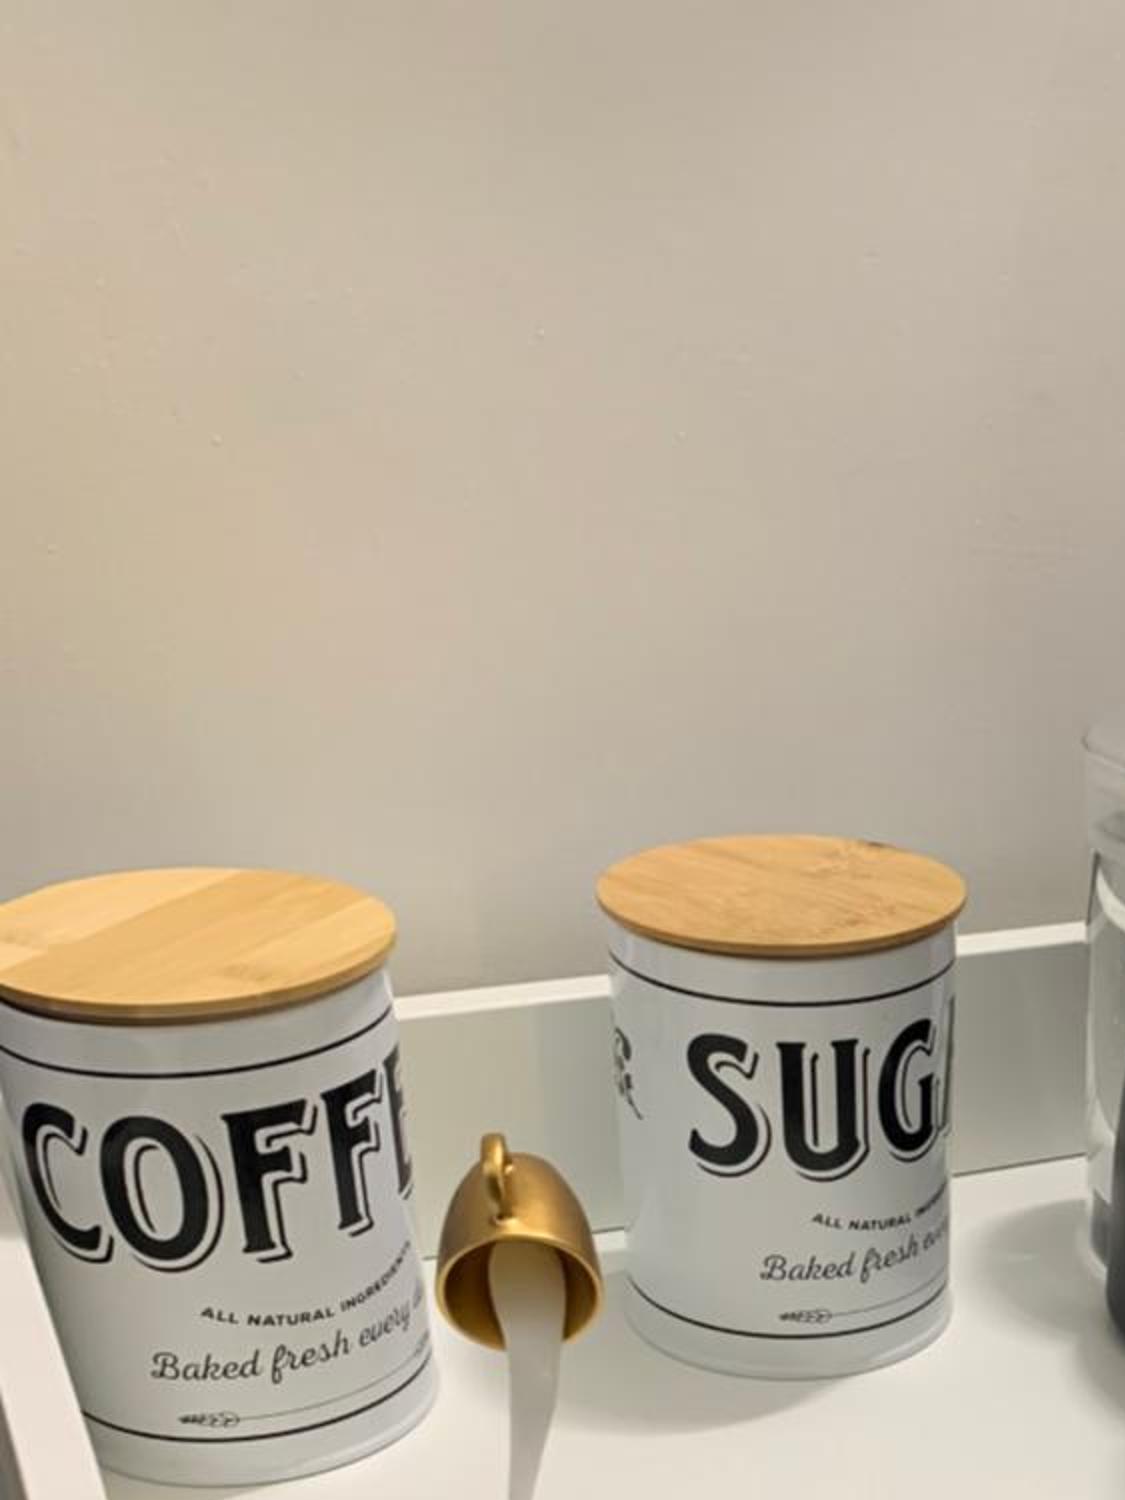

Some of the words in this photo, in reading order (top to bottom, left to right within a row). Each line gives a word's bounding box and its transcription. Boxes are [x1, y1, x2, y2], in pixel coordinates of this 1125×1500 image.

[687, 1000, 956, 1182] SUG
[812, 1213, 843, 1230] ALL
[848, 1213, 912, 1231] NATURAL
[760, 1251, 856, 1281] Baked
[860, 1233, 919, 1284] fresh
[200, 1306, 239, 1325] ALL
[247, 1307, 336, 1328] NATURAL
[150, 1348, 262, 1382] Baked
[270, 1329, 351, 1385] fresh
